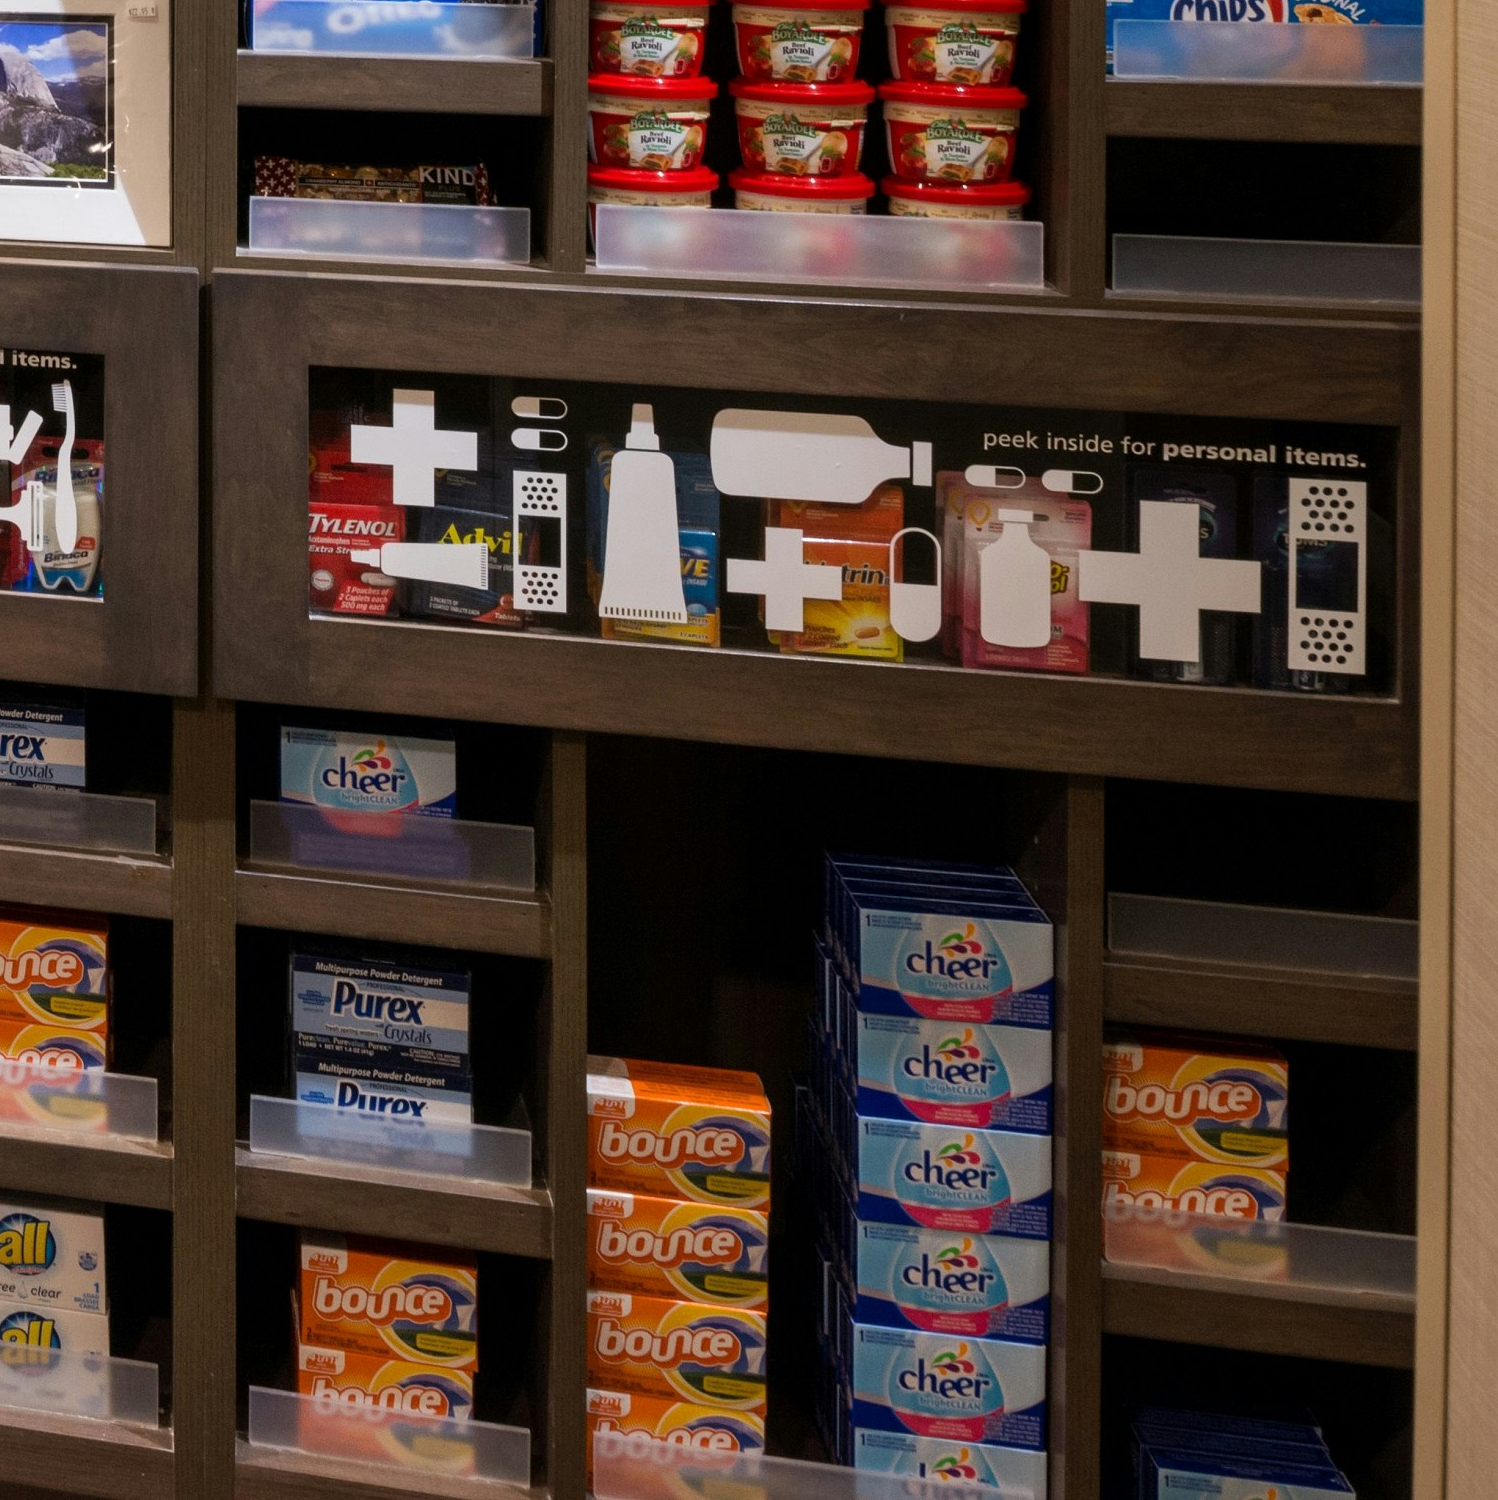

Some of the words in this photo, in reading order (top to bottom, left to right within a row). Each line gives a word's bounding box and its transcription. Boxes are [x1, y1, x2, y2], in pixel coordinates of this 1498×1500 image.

[419, 166, 476, 186] KIND
[12, 350, 77, 370] items.
[983, 429, 1039, 451] peek
[1047, 431, 1113, 454] inside
[1120, 436, 1156, 457] for
[1162, 441, 1276, 464] personal
[1285, 445, 1367, 468] items.
[308, 513, 396, 537] TYLENOL
[346, 594, 371, 603] Caplets
[353, 587, 377, 596] Pouches
[379, 588, 390, 596] of
[371, 603, 386, 611] each
[25, 709, 63, 723] Detergent
[9, 762, 54, 779] Crystals
[322, 756, 406, 794] cheer
[906, 940, 998, 981] cheer
[315, 962, 368, 977] Multipurpose
[370, 968, 400, 981] Powder
[402, 972, 443, 986] Detergent
[333, 980, 424, 1025] Purex
[384, 1024, 433, 1045] Crystals
[903, 1044, 996, 1084] cheer
[601, 1123, 738, 1163] bounce
[30, 1286, 61, 1299] clear
[315, 1278, 444, 1320] bounce
